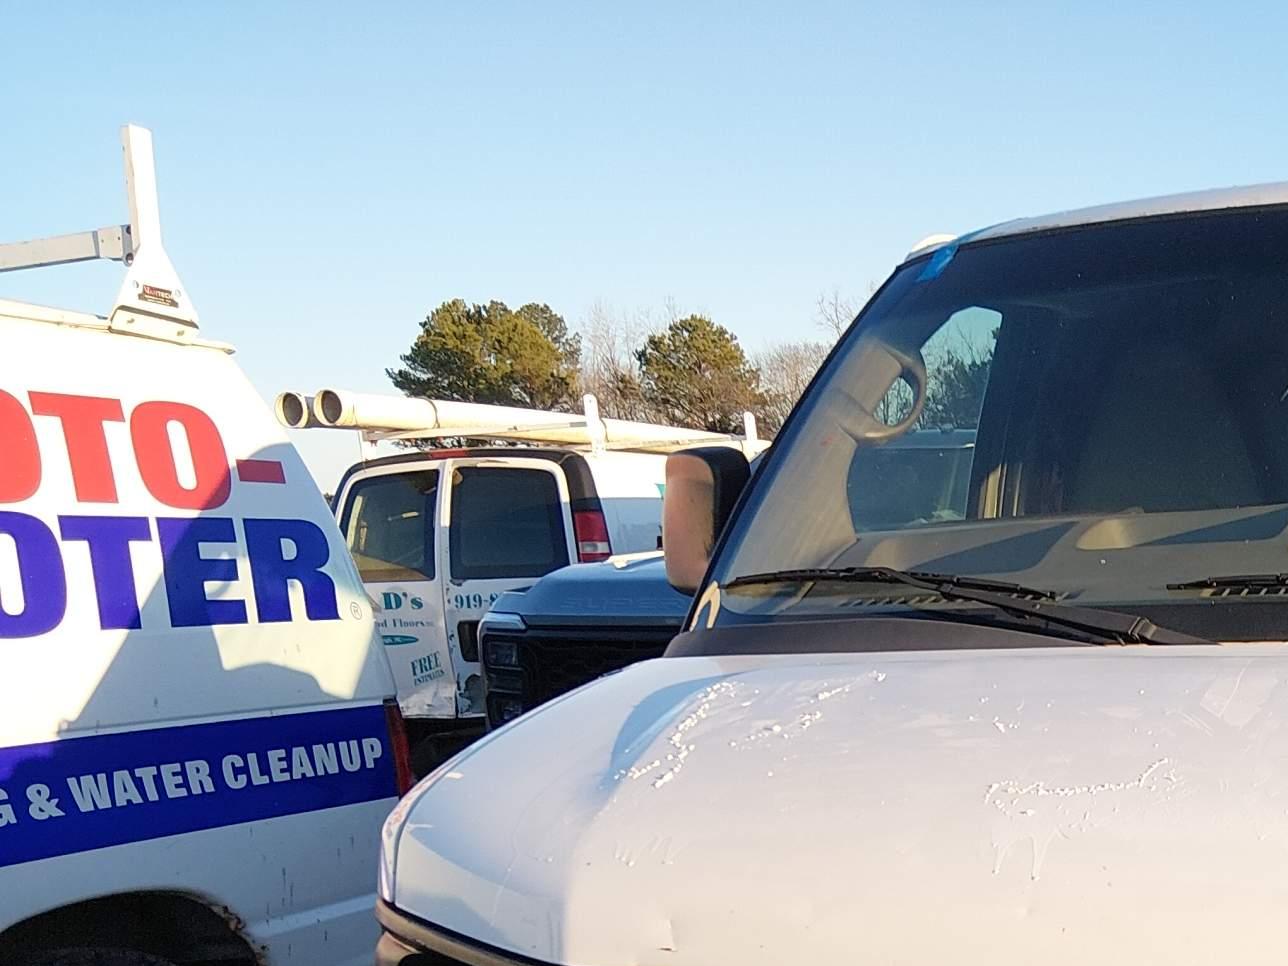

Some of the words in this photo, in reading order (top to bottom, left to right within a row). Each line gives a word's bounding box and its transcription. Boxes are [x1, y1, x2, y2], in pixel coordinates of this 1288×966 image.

[381, 592, 424, 610] D's
[411, 651, 441, 677] FREE
[26, 783, 65, 820] &
[67, 759, 215, 812] WATER
[222, 737, 382, 789] CLEANUP
